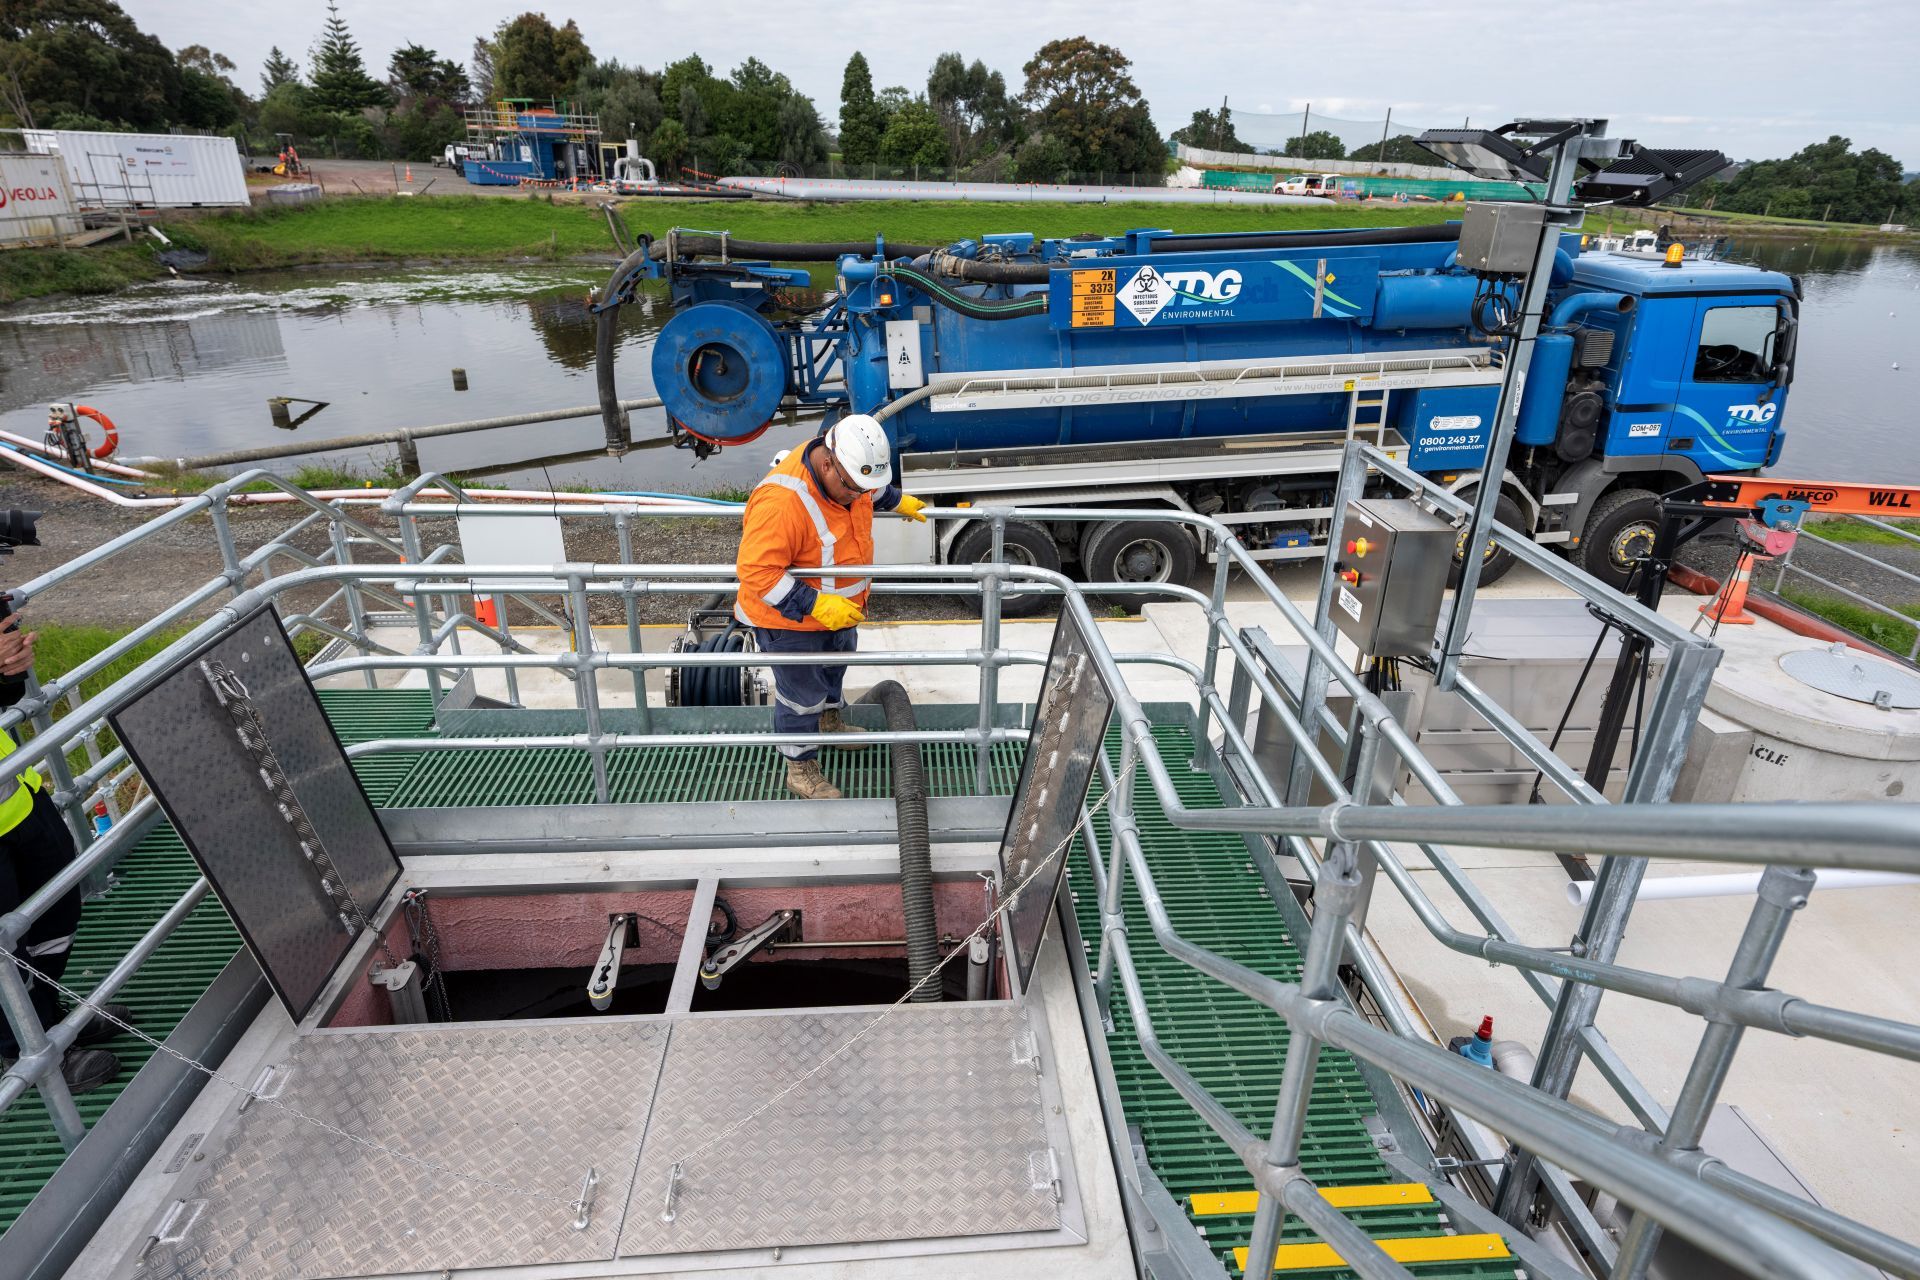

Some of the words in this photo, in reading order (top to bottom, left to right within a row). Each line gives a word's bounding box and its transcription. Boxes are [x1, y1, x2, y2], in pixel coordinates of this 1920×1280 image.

[10, 187, 57, 201] VEOLIA
[1101, 270, 1114, 281] 2X
[1090, 283, 1113, 294] 3373
[1163, 269, 1242, 306] TDG
[1162, 309, 1235, 319] ENVIRONMENTAL
[1274, 378, 1426, 391] www.hydrotedrainage.co.nz
[1039, 394, 1066, 404] NO
[1072, 392, 1101, 403] DIG
[1110, 386, 1224, 401] TECHNOLOGY
[1726, 402, 1776, 427] TDG
[1721, 428, 1767, 436] ENVIRONMENTAL
[1420, 436, 1446, 446] 0800
[1447, 435, 1466, 445] 249
[1467, 435, 1480, 443] 37
[1869, 491, 1912, 508] WLL
